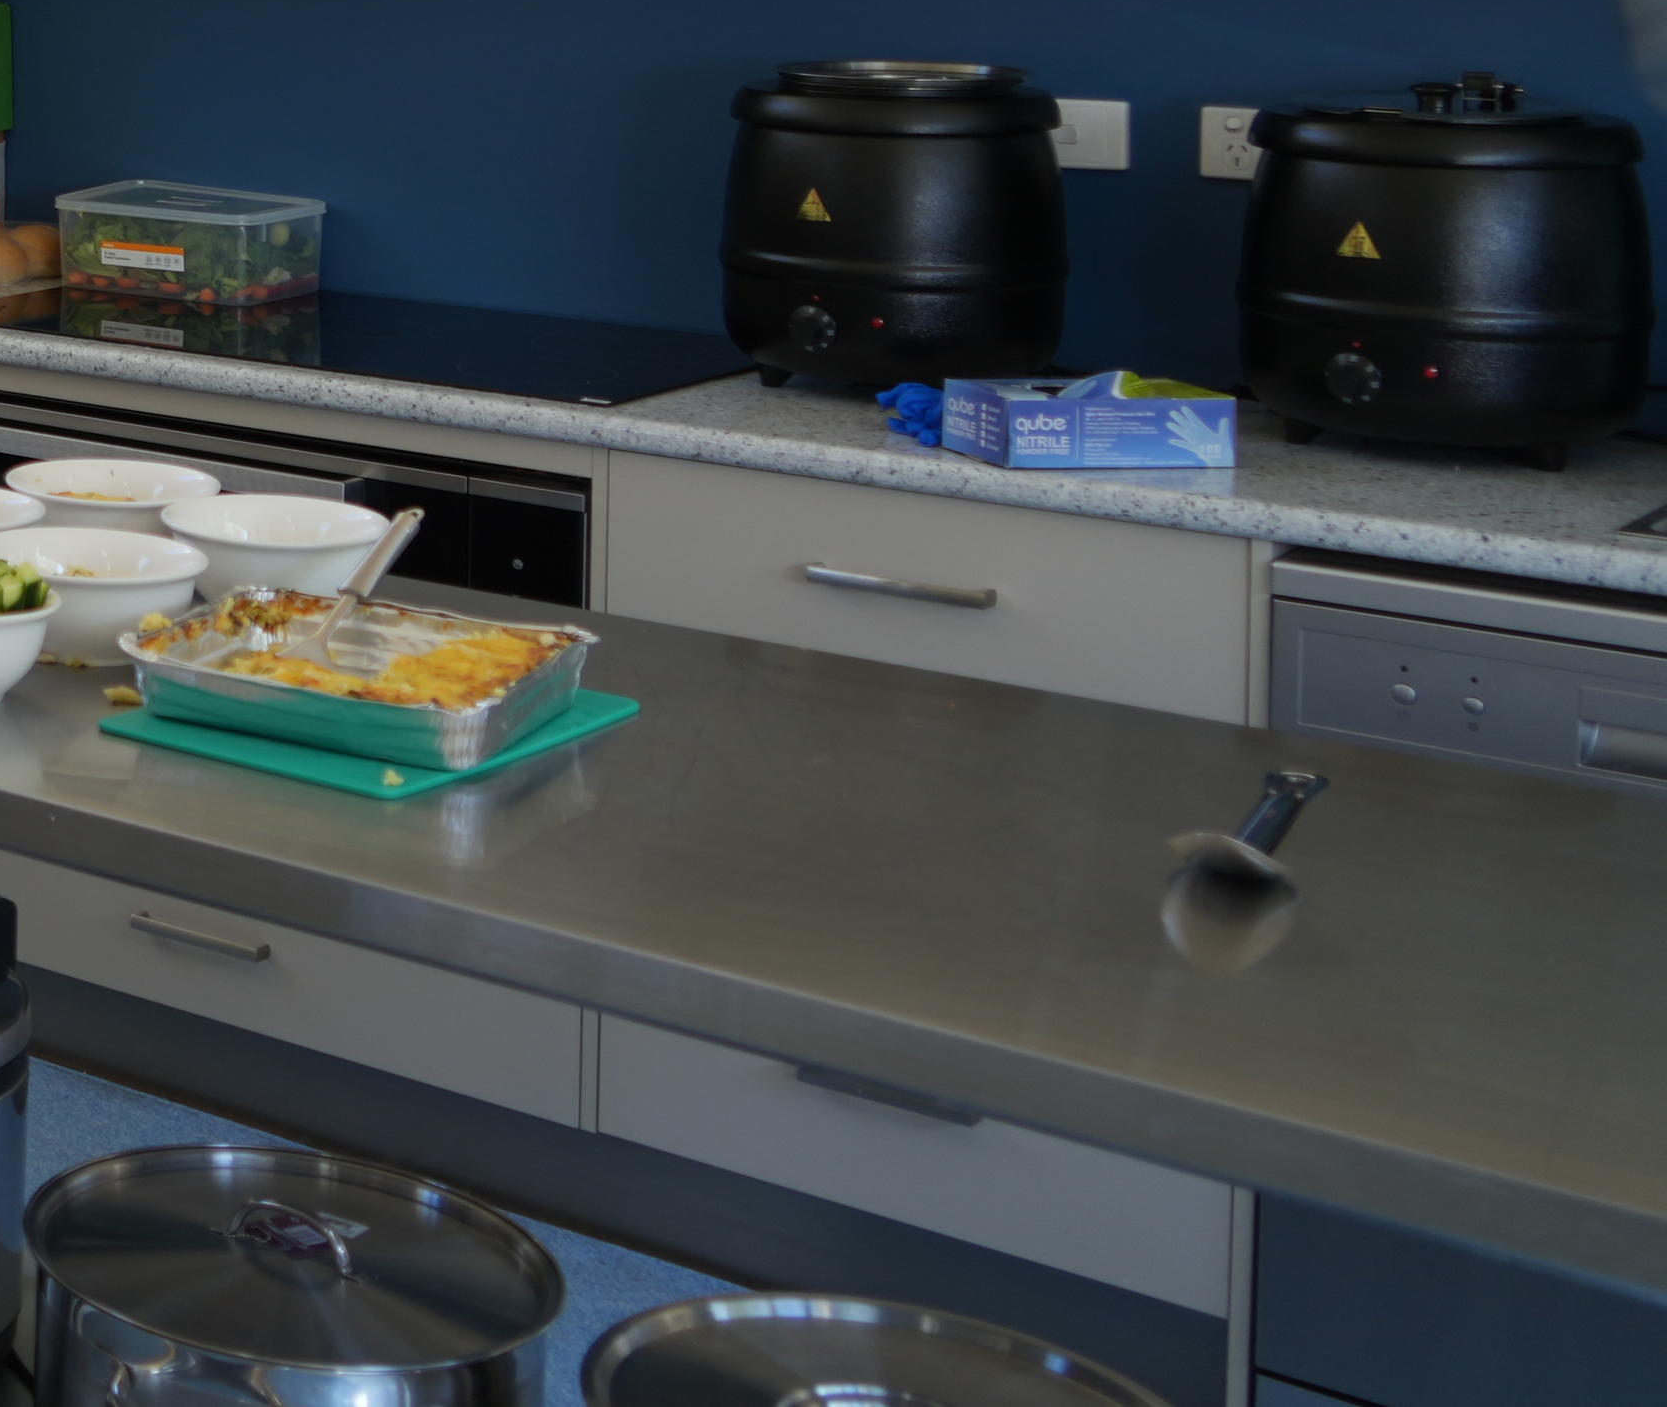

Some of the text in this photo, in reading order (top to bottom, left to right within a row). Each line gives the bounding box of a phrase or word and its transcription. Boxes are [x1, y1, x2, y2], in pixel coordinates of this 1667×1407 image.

[947, 395, 976, 417] qube
[947, 415, 976, 433] NITRILE
[1015, 414, 1066, 435] qube
[1016, 436, 1071, 448] NITRILE
